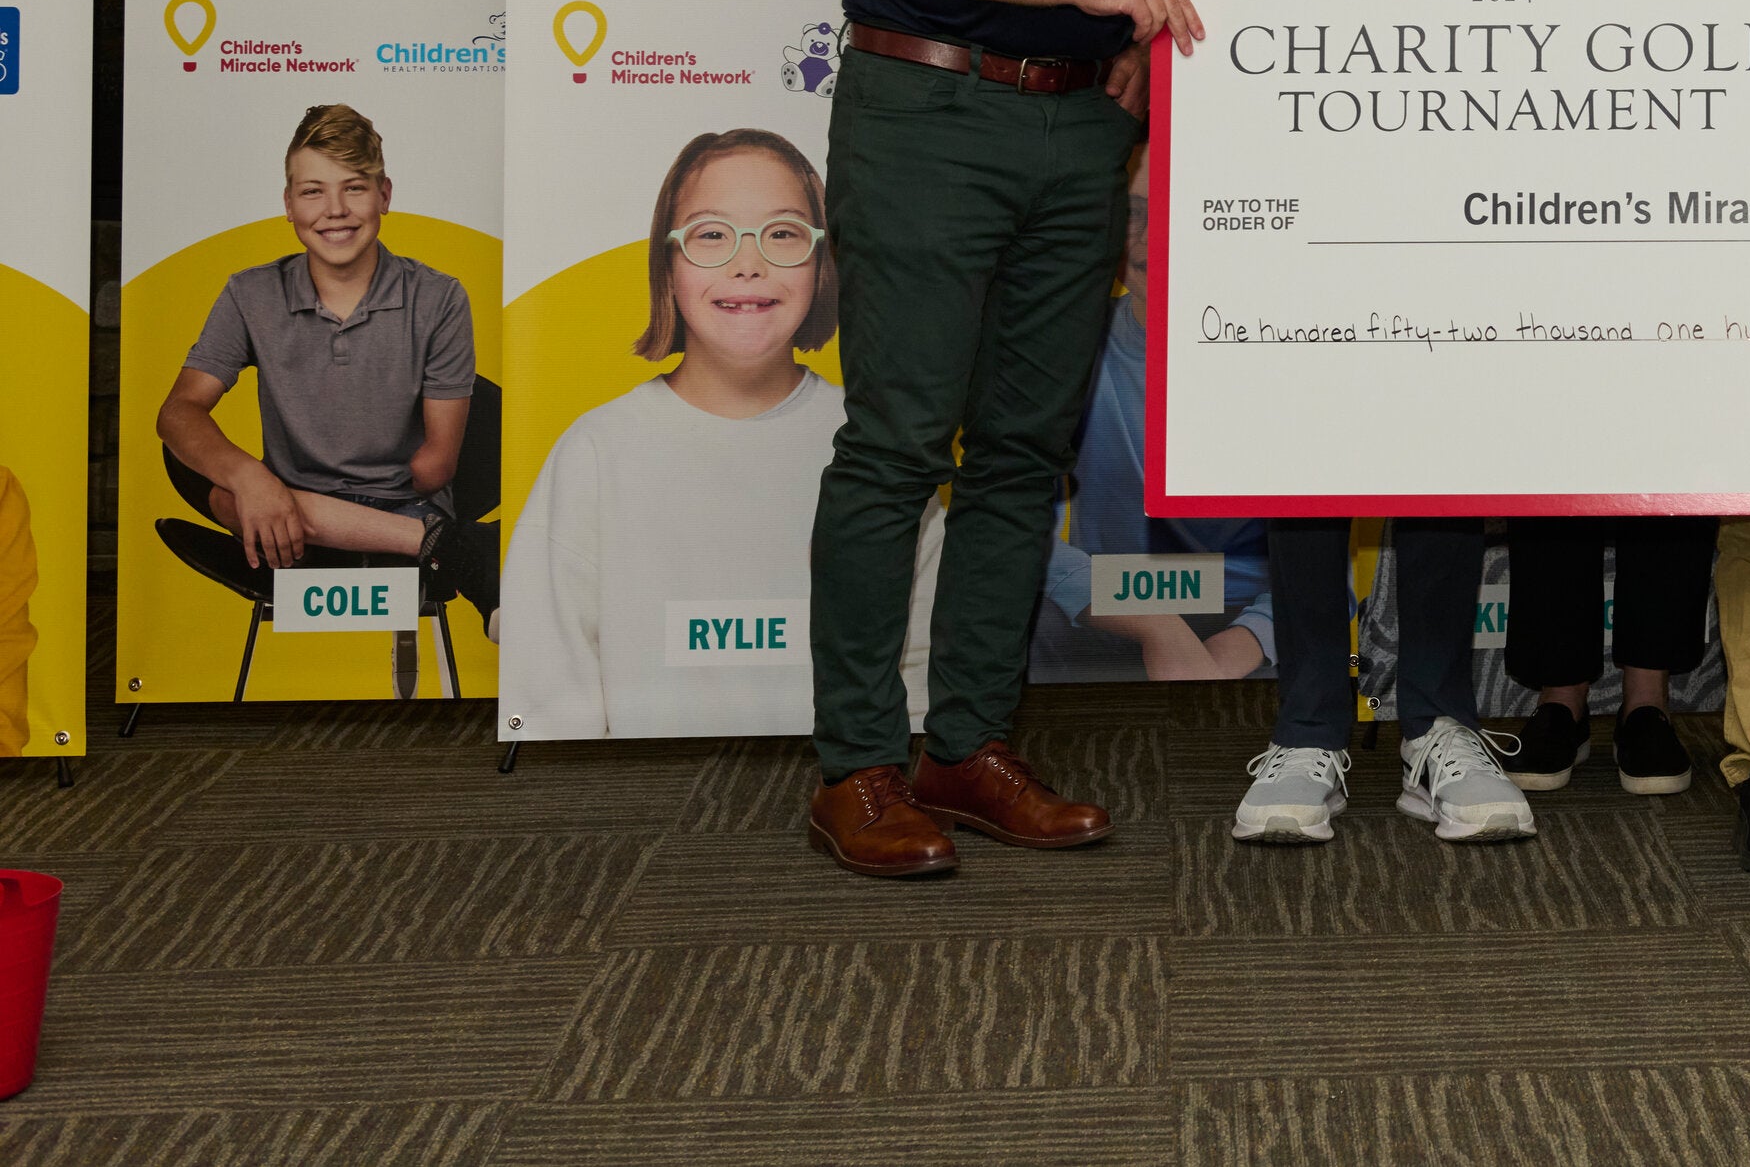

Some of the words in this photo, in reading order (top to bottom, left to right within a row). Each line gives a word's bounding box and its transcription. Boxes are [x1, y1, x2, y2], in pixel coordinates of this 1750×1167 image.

[220, 40, 302, 55] Children's
[1229, 24, 1562, 75] CHARITY
[220, 58, 283, 73] Miracle
[287, 58, 356, 73] Network
[611, 50, 697, 66] Children's
[383, 65, 426, 73] HEALTH
[611, 69, 674, 85] Miracle
[680, 69, 752, 85] Network
[1278, 88, 1728, 133] TOURNAMENT
[1203, 198, 1238, 213] PAY
[1240, 198, 1262, 213] TO
[1264, 198, 1300, 213] THE
[1203, 216, 1265, 231] ORDER
[1270, 216, 1295, 231] OF
[1201, 304, 1250, 343] One
[1258, 315, 1357, 343] hundred
[1366, 310, 1498, 353] fifty-two
[1516, 310, 1633, 342] thousand
[1656, 319, 1705, 343] one
[1113, 569, 1201, 602] JOHN
[302, 585, 390, 617] COLE
[688, 617, 787, 651] RYLIE
